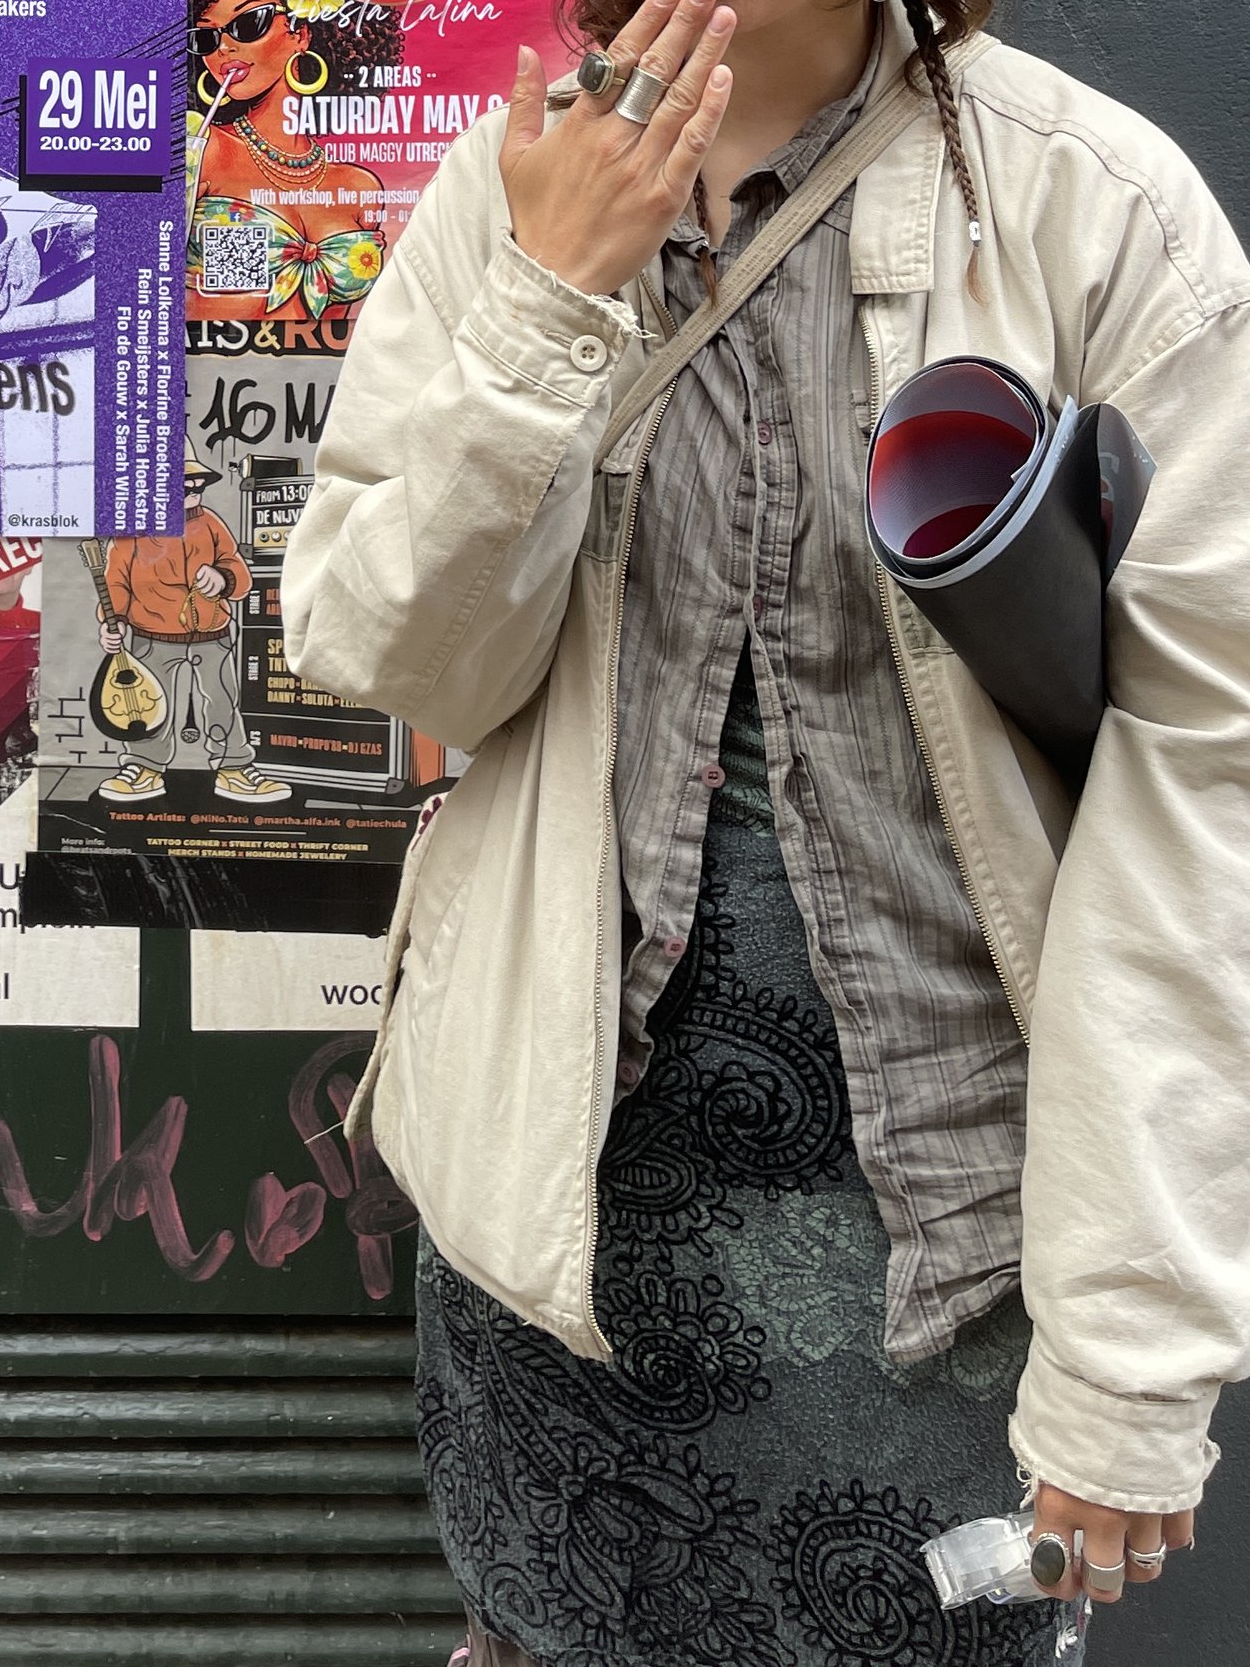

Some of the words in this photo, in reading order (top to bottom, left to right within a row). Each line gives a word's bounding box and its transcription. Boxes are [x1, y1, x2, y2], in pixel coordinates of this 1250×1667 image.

[358, 67, 369, 88] 2
[373, 66, 422, 88] AREAS
[38, 69, 84, 130] 29
[94, 69, 158, 131] Mei
[282, 94, 418, 136] SATURDAY
[423, 94, 479, 135] MAY
[40, 136, 152, 153] 20.00-23.00
[325, 142, 357, 163] CLUB
[359, 142, 403, 163] MAGGY
[7, 512, 81, 529] @krasblok
